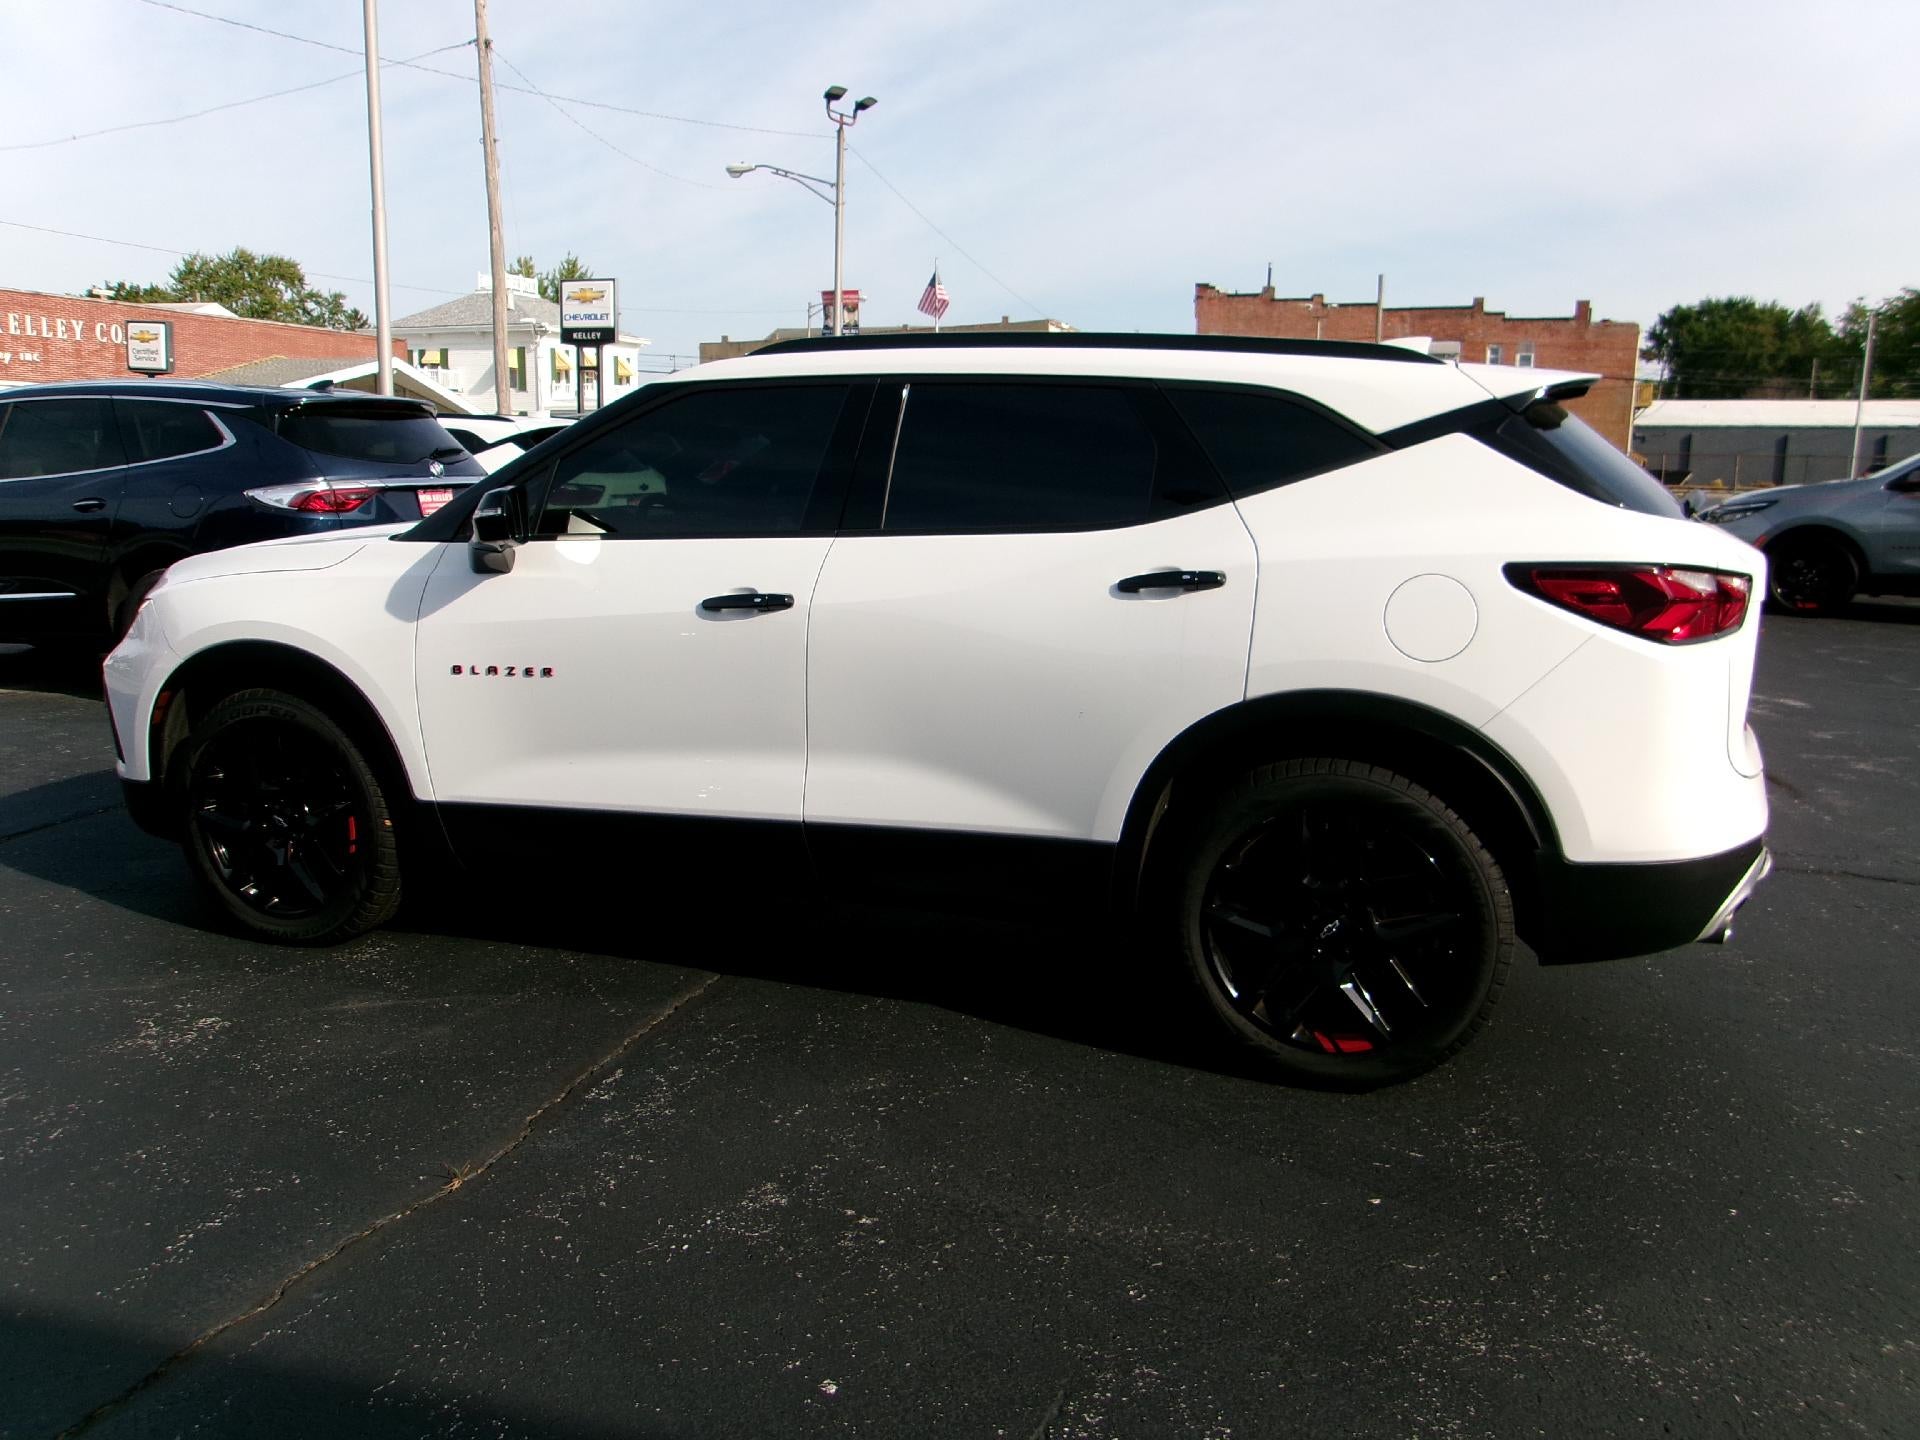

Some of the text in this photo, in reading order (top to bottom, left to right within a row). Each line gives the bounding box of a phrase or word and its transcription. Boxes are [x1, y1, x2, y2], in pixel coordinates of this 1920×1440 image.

[564, 313, 610, 322] CHEVROLET
[0, 313, 128, 344] ELLEY CO.
[573, 331, 602, 340] KELLEY
[131, 347, 159, 355] Certified
[133, 354, 157, 362] Service
[451, 664, 554, 677] BLAZER
